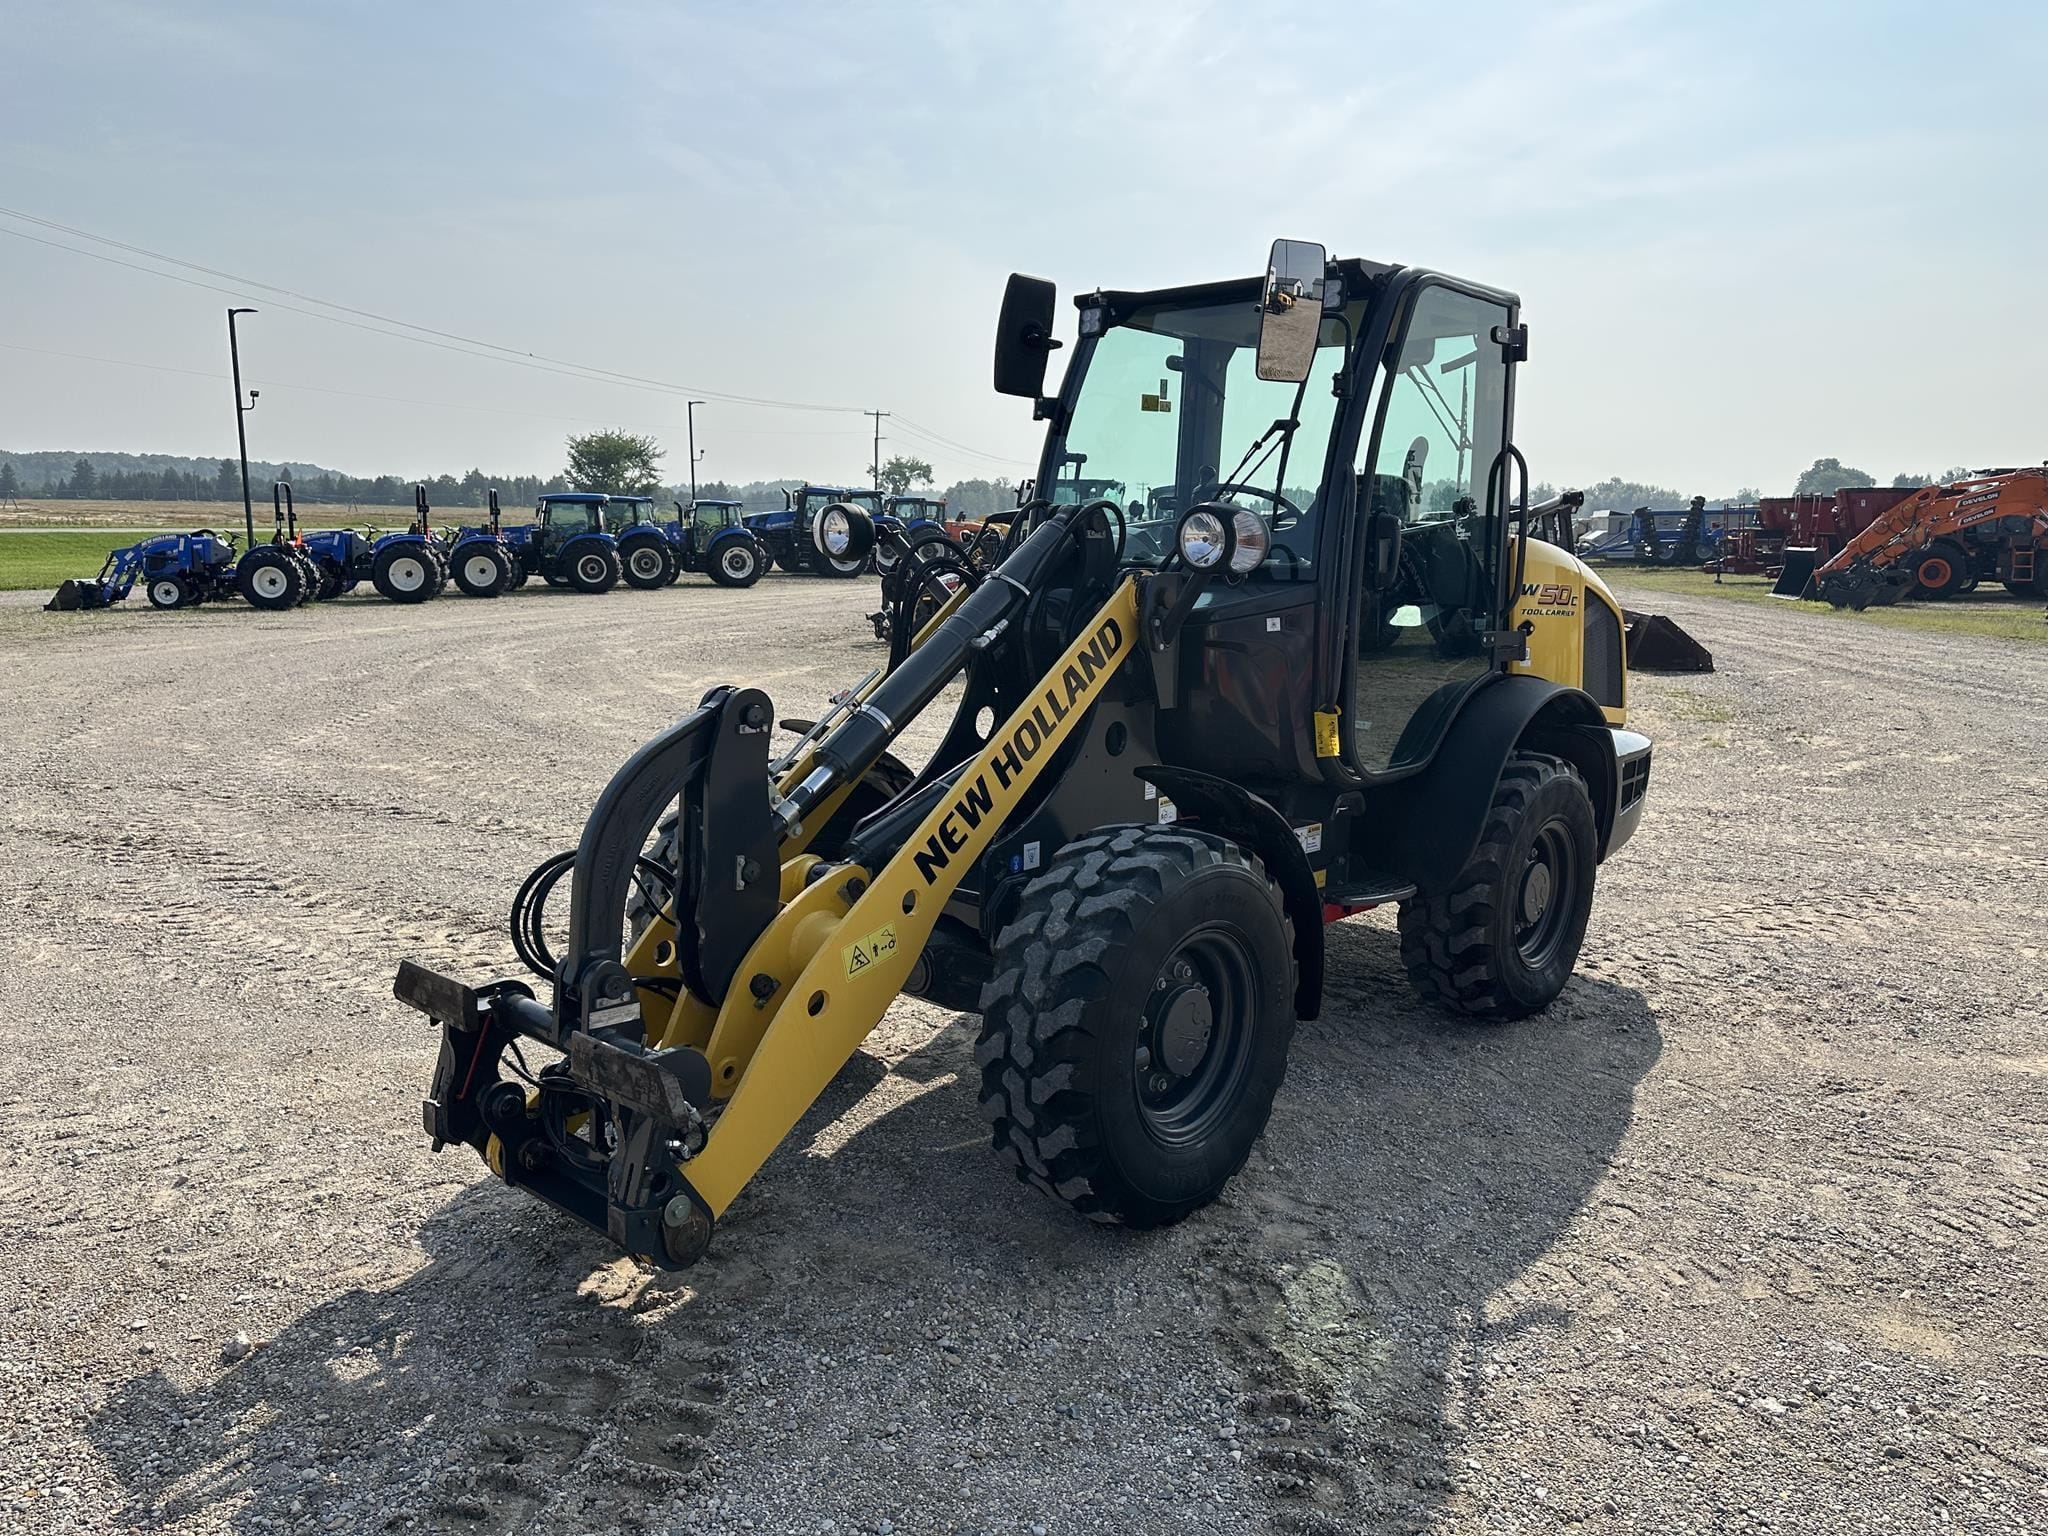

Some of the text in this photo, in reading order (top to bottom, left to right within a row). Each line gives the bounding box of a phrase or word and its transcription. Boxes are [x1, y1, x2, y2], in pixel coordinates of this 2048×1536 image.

[1962, 492, 1999, 506] DEVELON
[1963, 508, 1994, 523] DEVELON
[1521, 608, 1576, 617] TOOL CARRIER
[913, 617, 1123, 886] NEW HOLLAND
